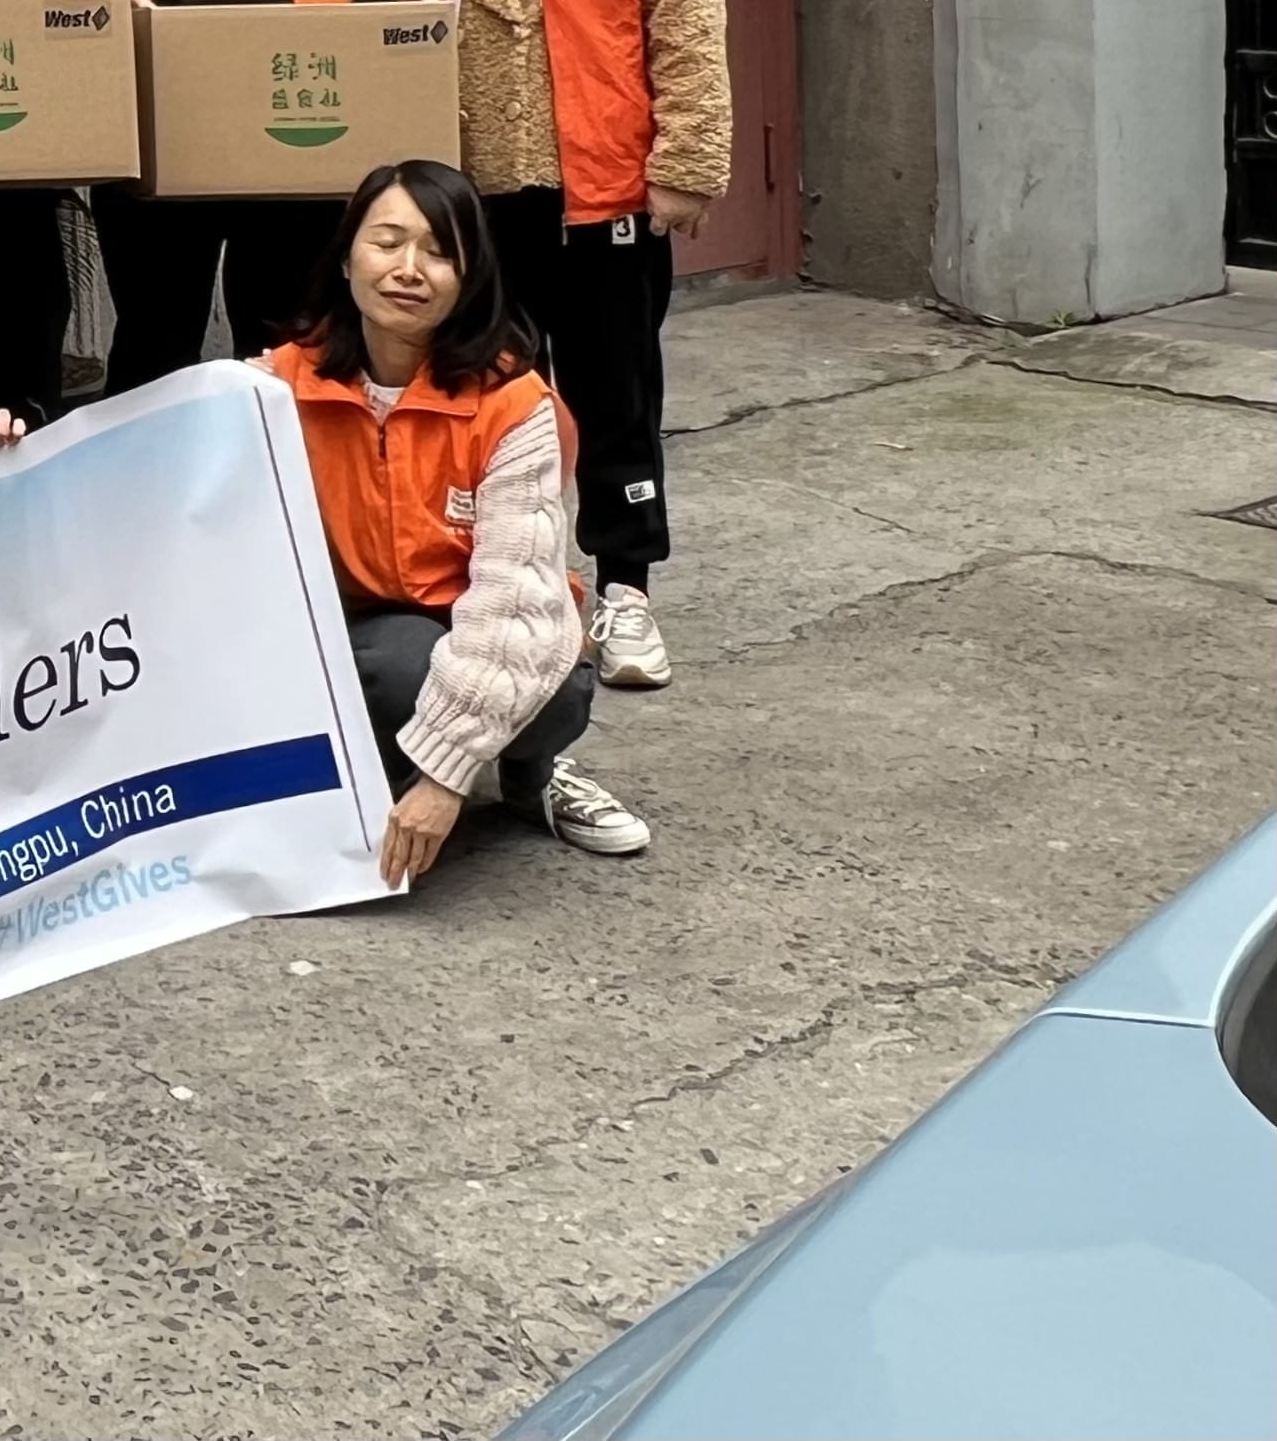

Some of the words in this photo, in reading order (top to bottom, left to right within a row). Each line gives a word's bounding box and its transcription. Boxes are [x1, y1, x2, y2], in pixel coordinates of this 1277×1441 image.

[44, 9, 91, 29] West
[383, 24, 429, 46] West
[81, 784, 177, 840] China
